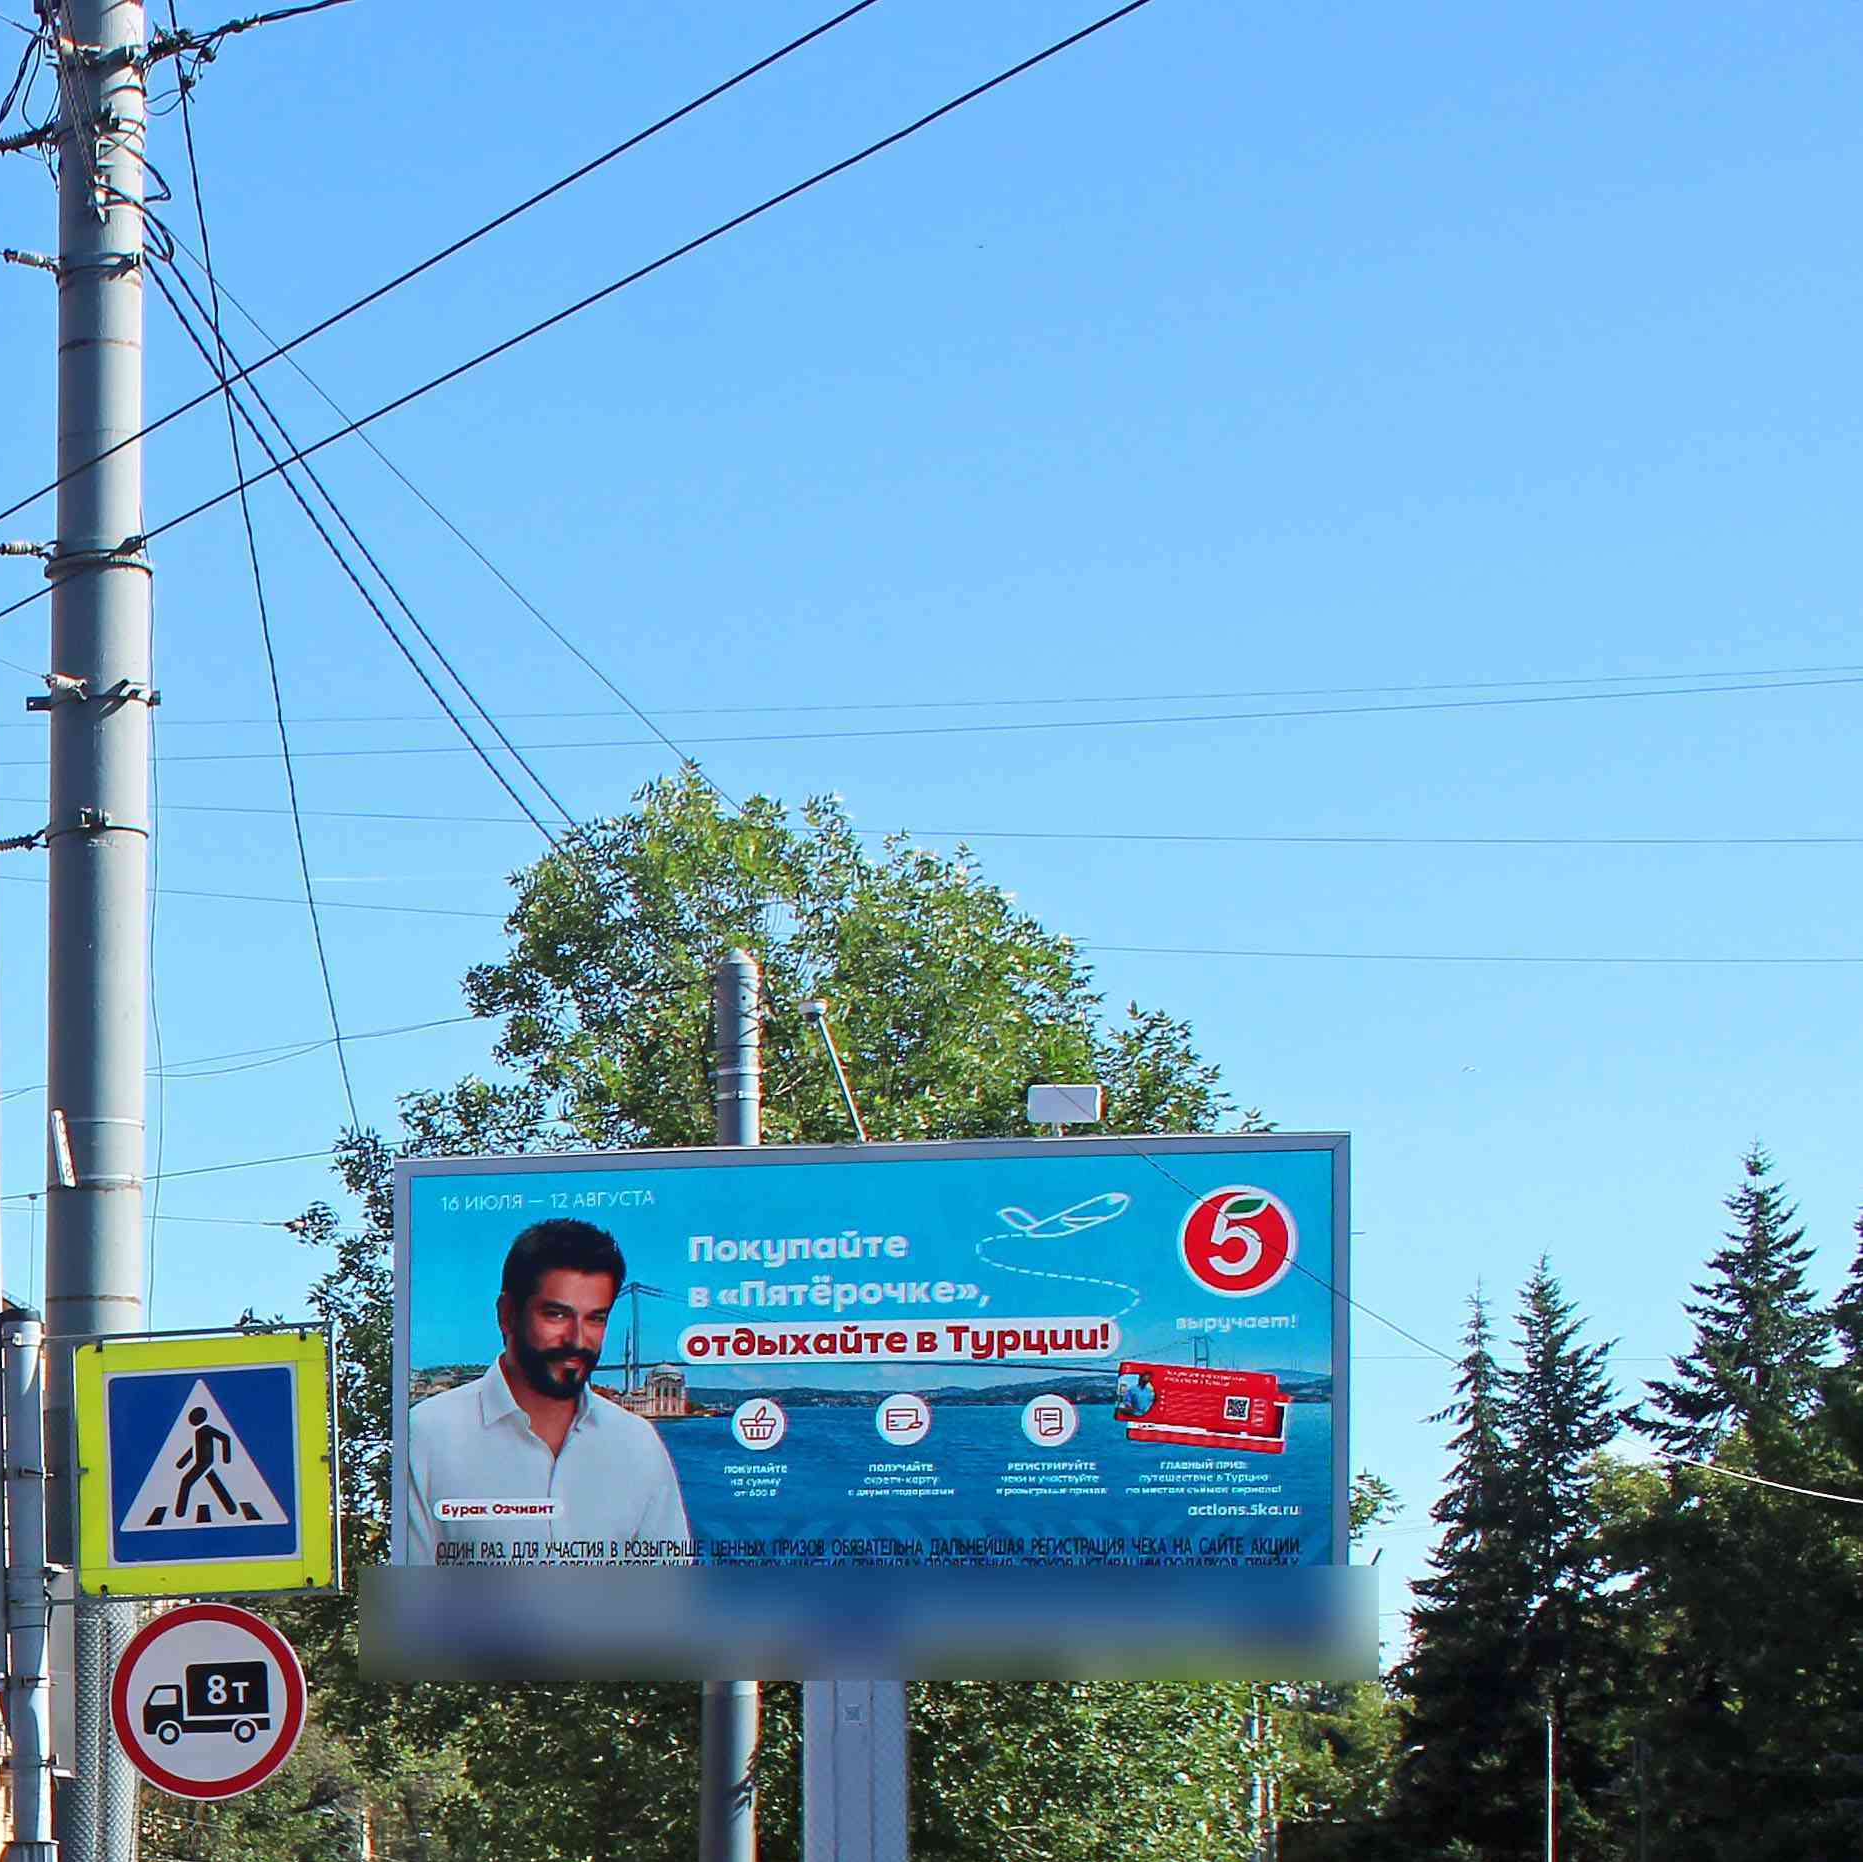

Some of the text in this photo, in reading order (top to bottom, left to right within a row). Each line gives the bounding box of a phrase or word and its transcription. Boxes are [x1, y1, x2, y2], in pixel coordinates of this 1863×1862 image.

[441, 1196, 460, 1211] 16
[465, 1194, 522, 1210] ИЮЛЯ
[550, 1194, 569, 1208] 12
[574, 1190, 655, 1208] АВГУСТА
[688, 1231, 909, 1268] Покупайте
[688, 1275, 991, 1312] в «Пятёрочке»,
[1176, 1314, 1298, 1333] выручает!
[686, 1323, 1110, 1359] отдыхайте в Турции!
[724, 1462, 788, 1474] ПОКУПАЙТЕ
[869, 1461, 934, 1473] ПОЛУЧАЙТЕ
[1008, 1460, 1096, 1472] РЕГИСТРИРУЙТЕ
[1160, 1459, 1213, 1470] ГЛАВНЫЙ
[442, 1503, 555, 1518] Бурак Озчивит
[1188, 1503, 1300, 1517] actions.5ka.ru
[436, 1542, 474, 1560] ОДИН
[511, 1541, 538, 1560] ДЛЯ
[546, 1541, 604, 1558] УЧАСТИЯ
[610, 1541, 618, 1556] В
[624, 1539, 704, 1557] РОЗЫГРЫШЕ
[711, 1538, 765, 1558] ЦЕННЫХ
[774, 1538, 825, 1555] ПРИЗОВ
[833, 1538, 923, 1555] ОБЯЗАТЕЛЬНА
[930, 1535, 1023, 1557] ДАЛЬНЕЙШАЯ
[1031, 1536, 1124, 1557] РЕГИСТРАЦИЯ
[1131, 1536, 1166, 1553] ЧЕКА
[1174, 1536, 1193, 1553] НА
[1199, 1533, 1243, 1553] САЙТЕ
